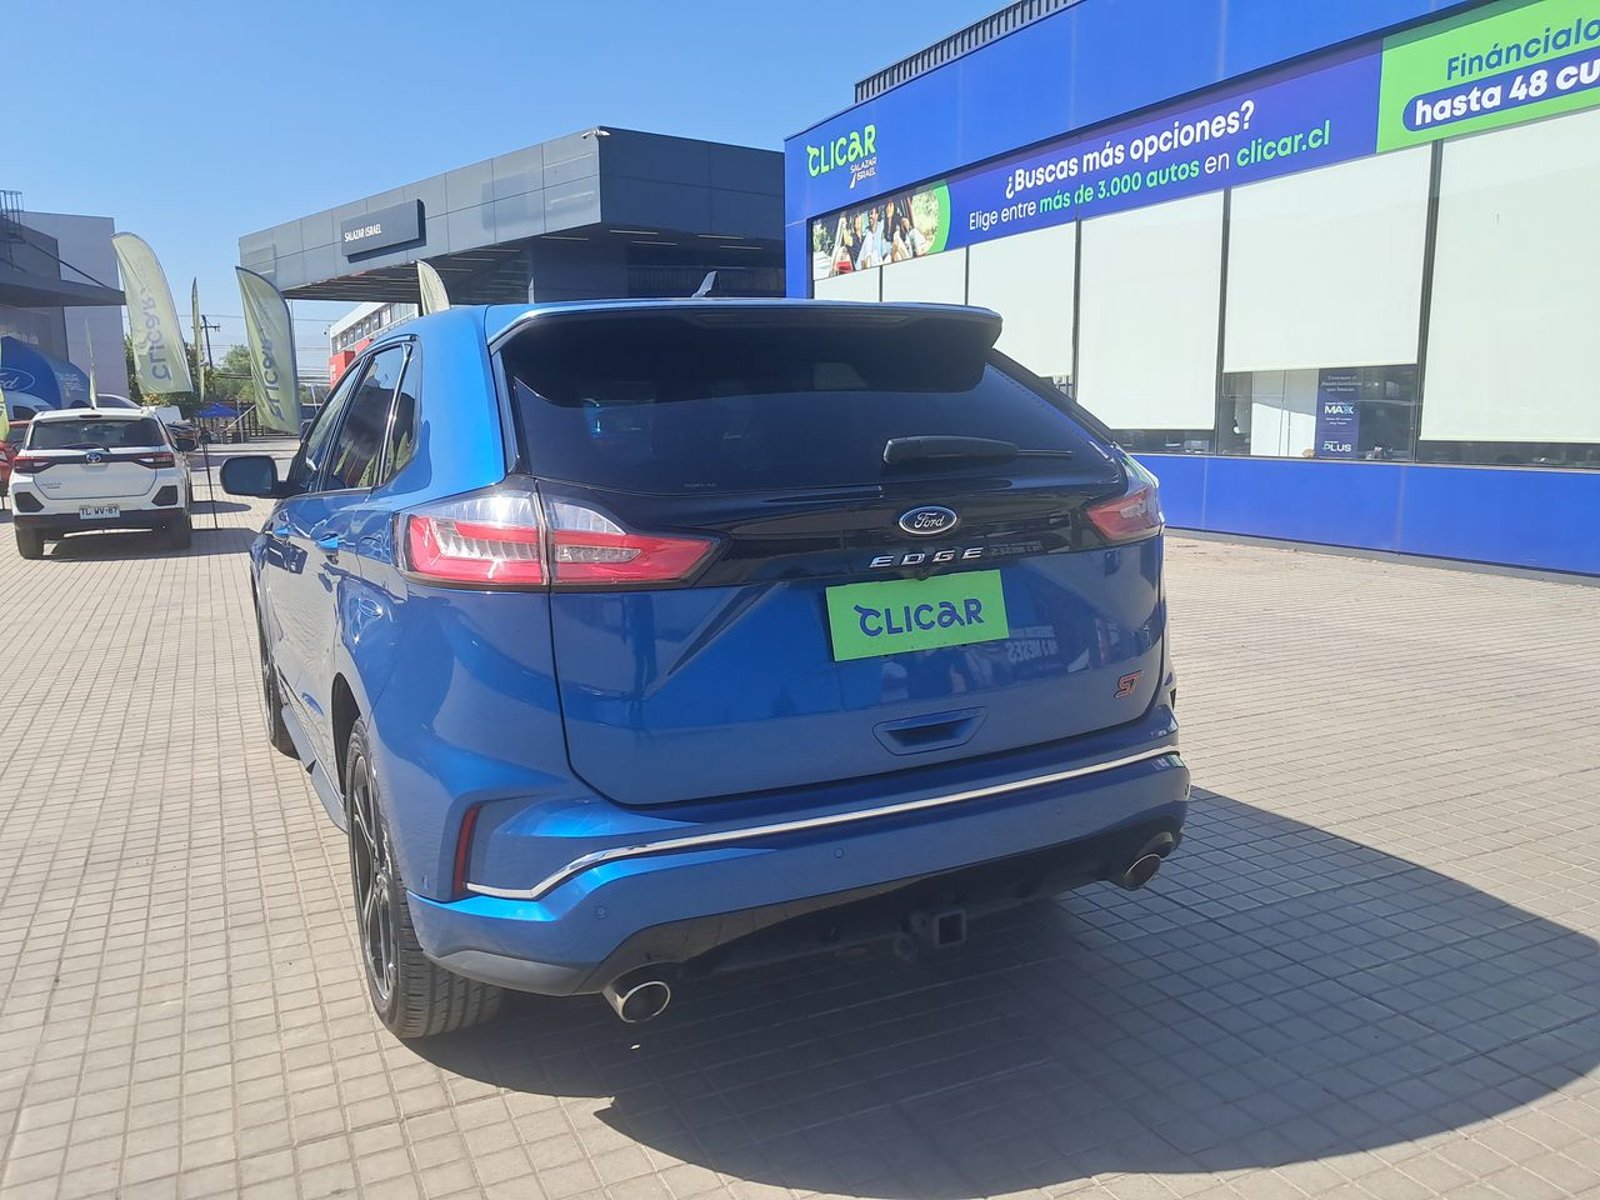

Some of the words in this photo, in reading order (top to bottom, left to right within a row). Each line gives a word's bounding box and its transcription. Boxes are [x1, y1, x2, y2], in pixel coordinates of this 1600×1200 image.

[1447, 18, 1600, 80] Fináncialo
[1415, 85, 1501, 126] hasta
[1508, 69, 1549, 101] 48
[1005, 157, 1078, 199] ¿Buscas
[1082, 141, 1125, 173] más
[1130, 100, 1255, 163] opciones?
[850, 156, 877, 174] SALAZAR
[969, 210, 998, 231] Elige
[1001, 201, 1037, 222] entre
[1039, 189, 1070, 213] más
[1074, 184, 1094, 205] de
[1098, 172, 1142, 199] 3.000
[1146, 160, 1200, 188] autos
[1204, 152, 1230, 174] en
[1236, 120, 1331, 167] clicar.cl
[344, 227, 365, 243] SALAZAR
[364, 223, 382, 239] ISRAEL
[1323, 443, 1352, 453] PLUS
[869, 546, 985, 568] EDGE
[1113, 670, 1143, 698] ST
